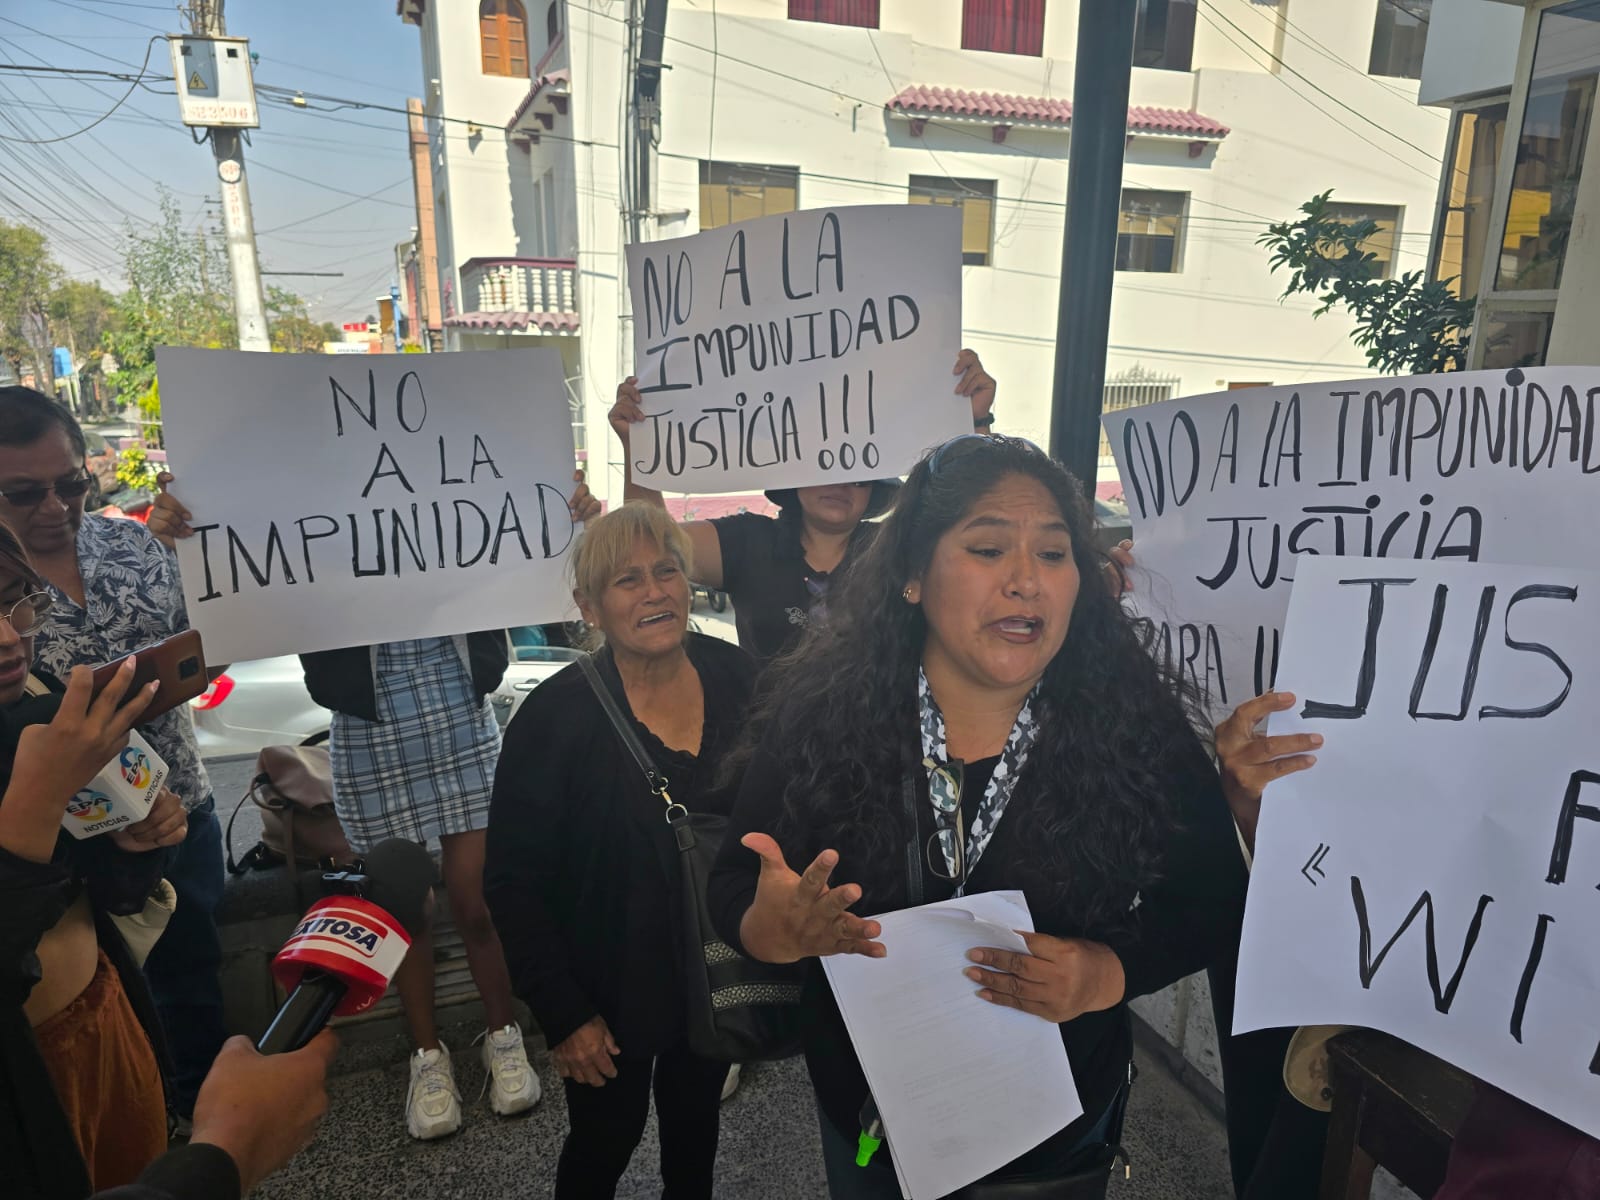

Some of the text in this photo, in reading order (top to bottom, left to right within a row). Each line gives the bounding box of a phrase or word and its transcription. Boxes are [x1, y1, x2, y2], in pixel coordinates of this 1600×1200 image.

[643, 212, 844, 339] NO A LA
[638, 295, 921, 394] IMPUNIDAD
[328, 368, 428, 437] NO
[361, 433, 504, 498] A LA
[1122, 409, 1201, 519] NO
[1209, 402, 1240, 493] A
[1259, 391, 1303, 488] LA
[192, 483, 575, 602] IMPUNIDAD
[1299, 576, 1579, 723] JUS
[126, 753, 146, 785] EPA
[144, 769, 163, 804] NOTICIAS
[65, 796, 111, 814] EPA
[83, 815, 130, 833] NOTICIAS
